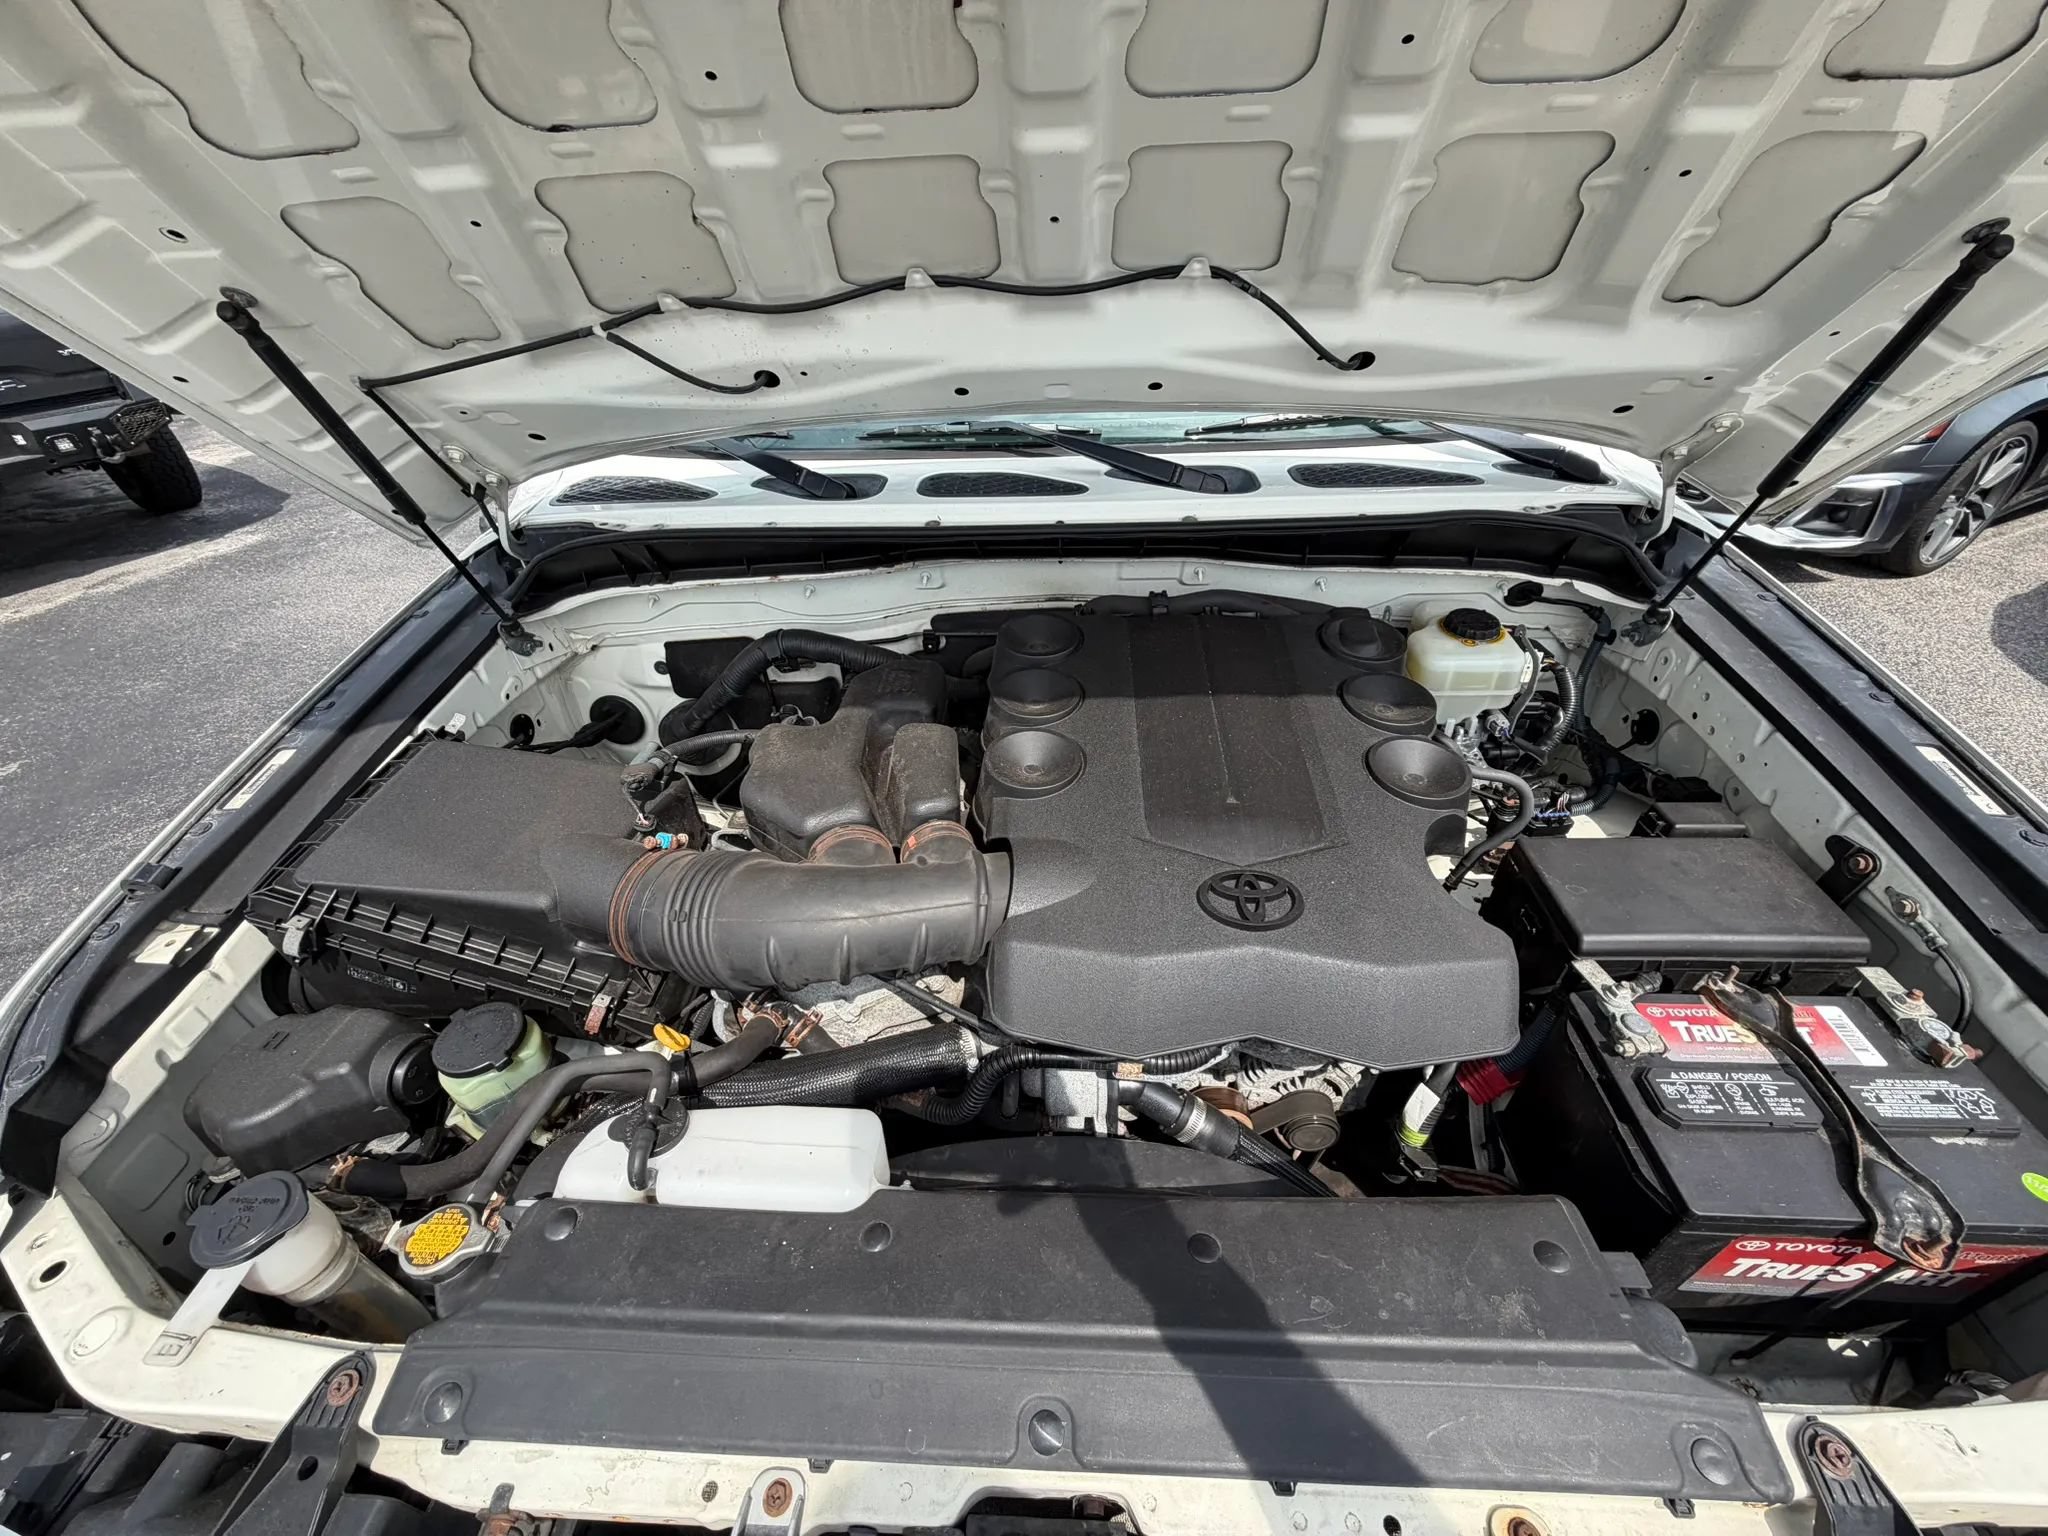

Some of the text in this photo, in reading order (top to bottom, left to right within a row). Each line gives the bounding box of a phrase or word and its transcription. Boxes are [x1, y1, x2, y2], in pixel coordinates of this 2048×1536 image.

[1666, 1008, 1719, 1017] TOYOTA
[1679, 1072, 1773, 1081] DANGER / POISON
[1775, 1242, 1863, 1254] TOYOTA
[1723, 1257, 1981, 1288] TRUESART
